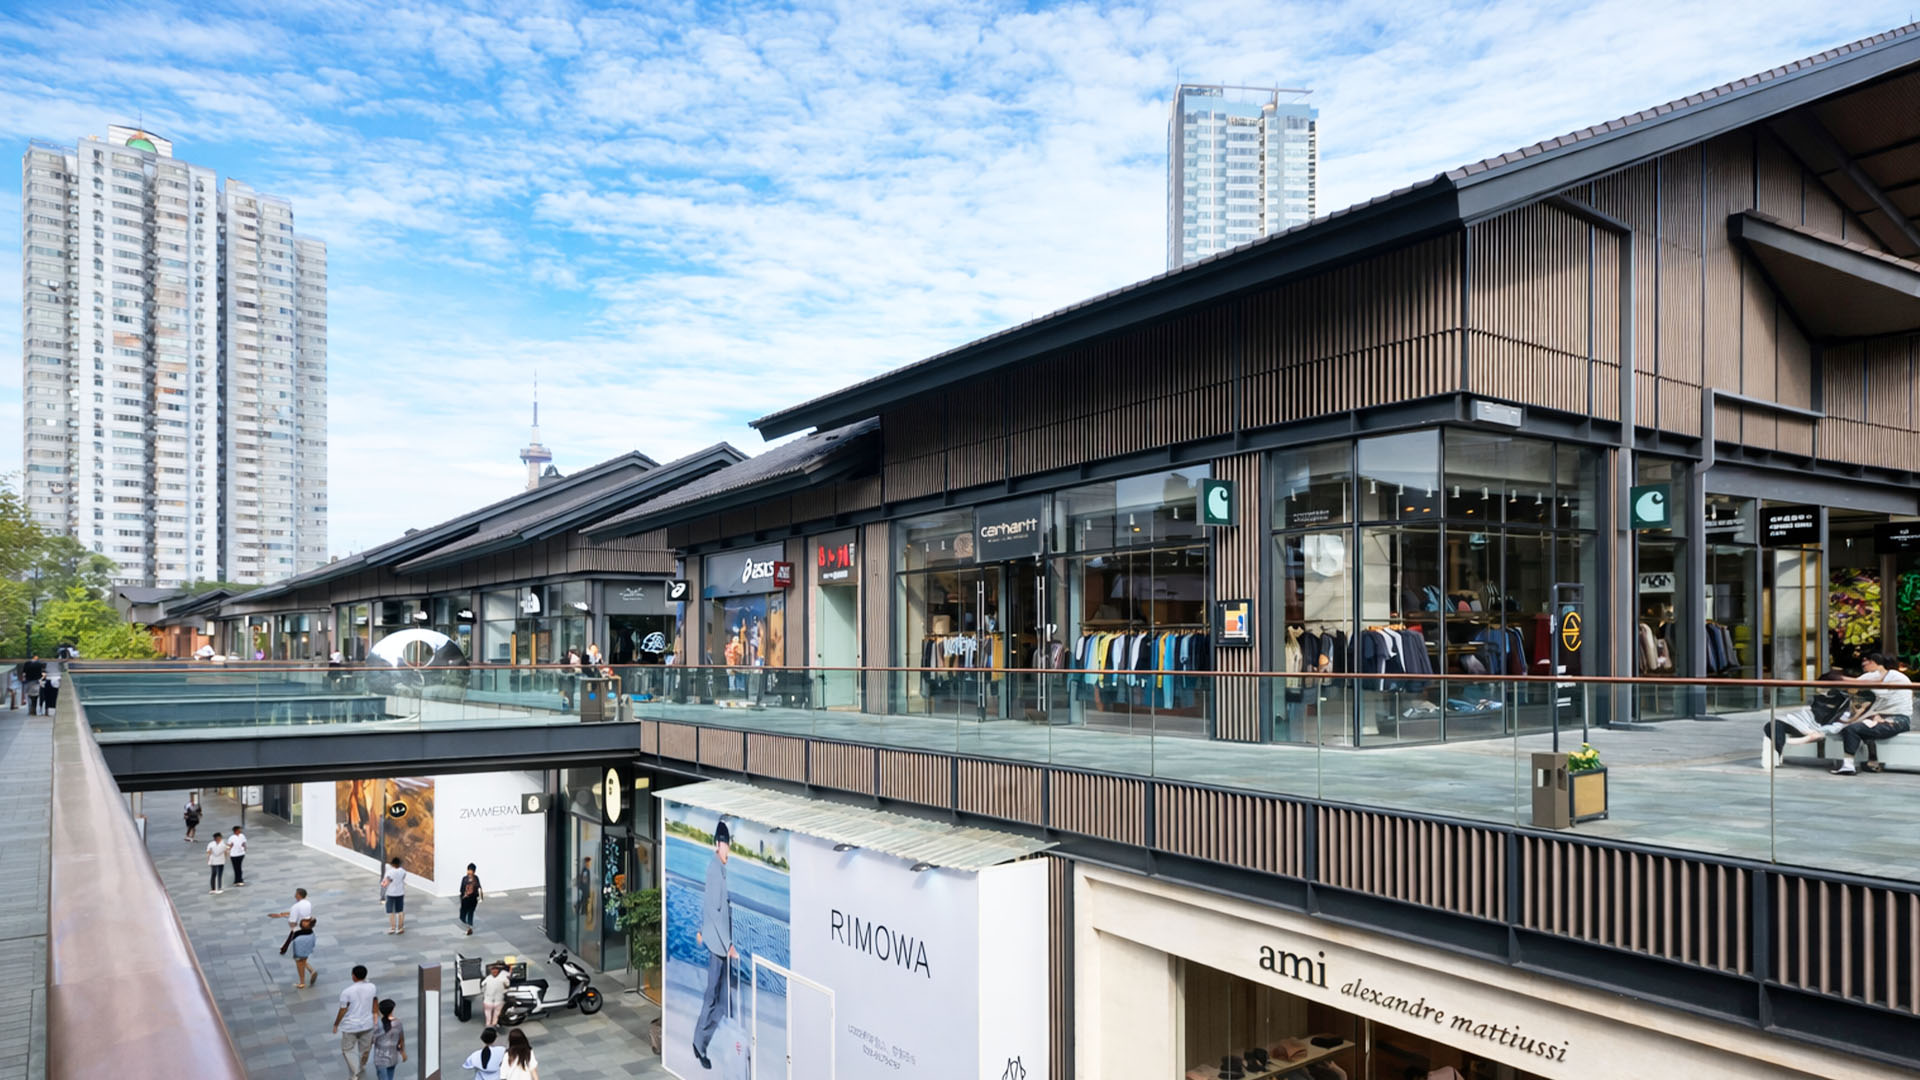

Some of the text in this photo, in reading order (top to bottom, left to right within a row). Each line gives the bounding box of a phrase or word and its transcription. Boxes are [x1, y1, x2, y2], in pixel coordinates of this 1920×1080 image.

[981, 518, 1038, 537] carhartt
[831, 909, 931, 979] RIMOWA
[1259, 944, 1570, 1064] ami alexandre mattiussi
